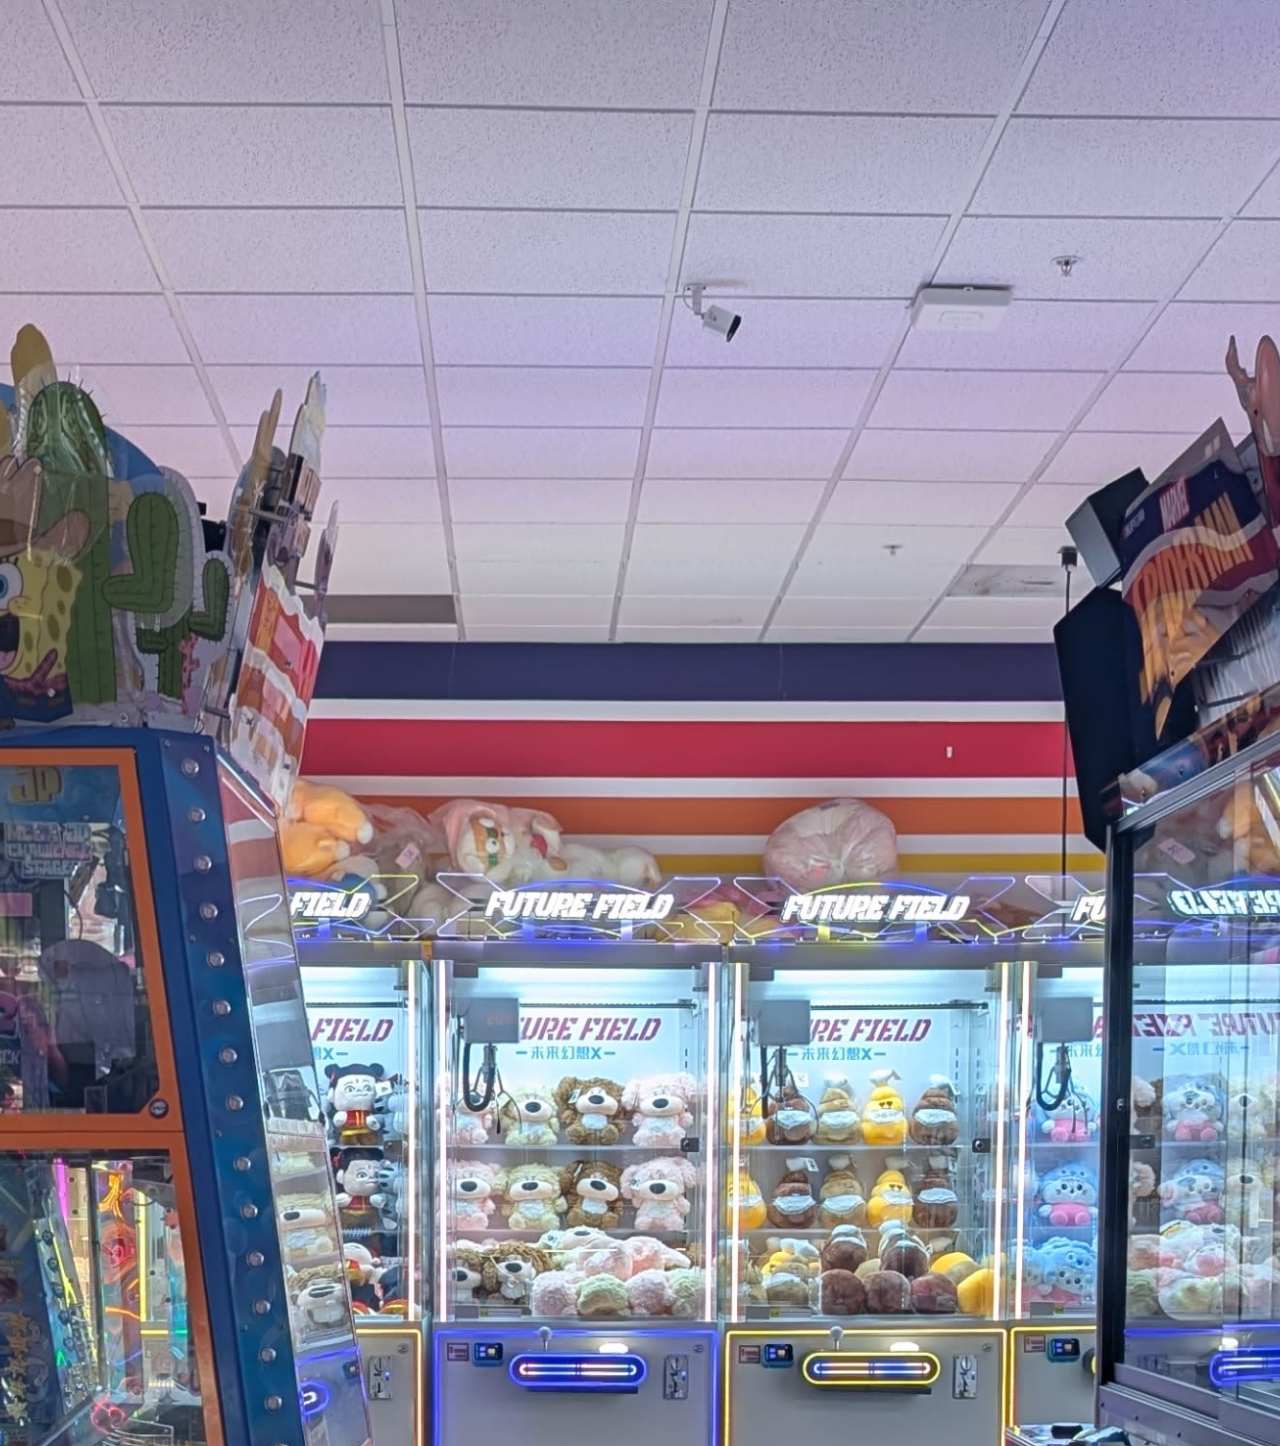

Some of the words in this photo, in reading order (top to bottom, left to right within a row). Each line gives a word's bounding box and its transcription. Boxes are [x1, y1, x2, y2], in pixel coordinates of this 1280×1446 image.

[290, 890, 372, 919] FIELD
[484, 891, 587, 919] FUTURE
[593, 892, 675, 920] FIELD
[781, 894, 888, 923] FUTURE
[886, 895, 971, 922] FIELD
[311, 1017, 394, 1042] FIELD
[579, 1017, 662, 1042] FIELD
[852, 1018, 932, 1042] FIELD
